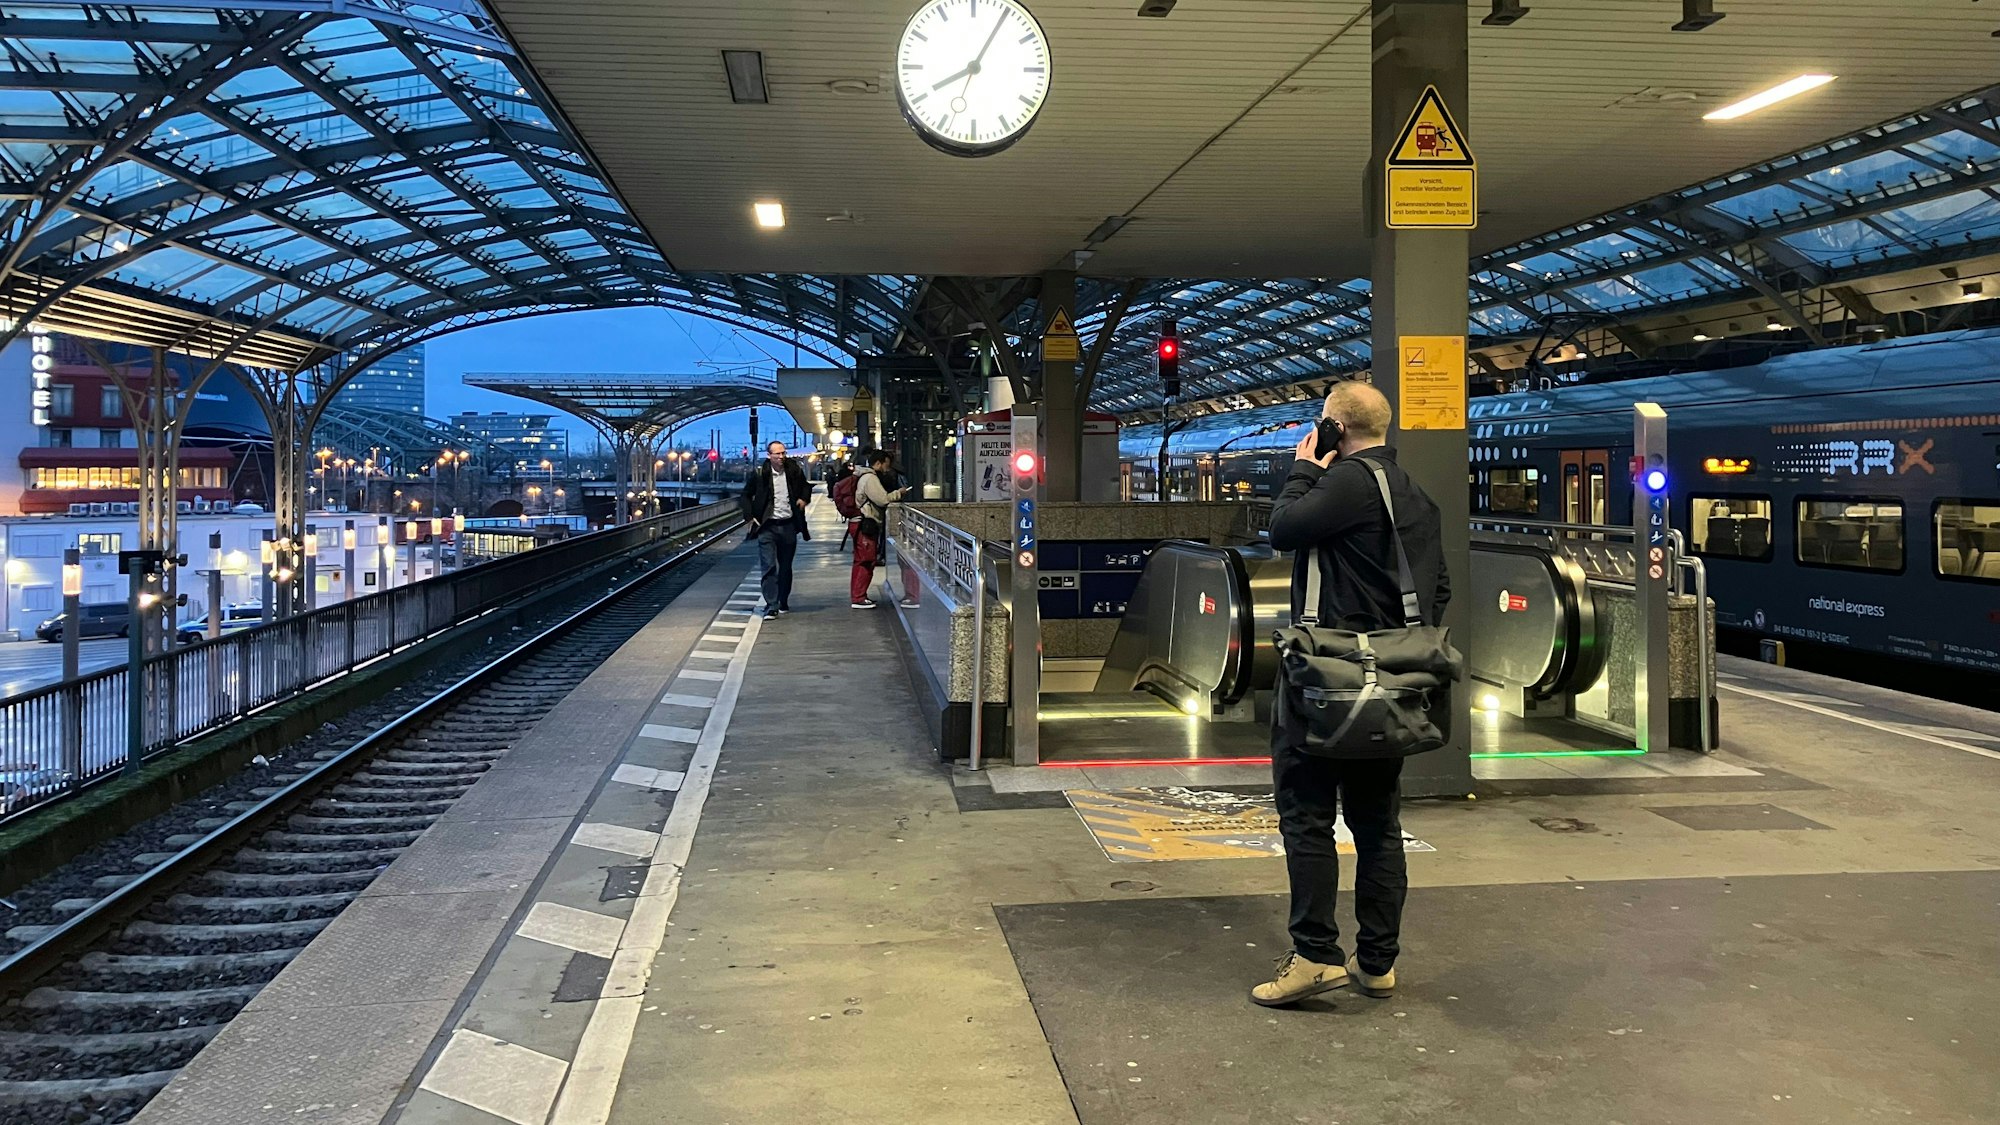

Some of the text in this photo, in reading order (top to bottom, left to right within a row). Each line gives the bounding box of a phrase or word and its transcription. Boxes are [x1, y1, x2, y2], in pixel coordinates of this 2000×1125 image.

[32, 335, 52, 426] HOTEL
[981, 441, 999, 449] HEUTE
[1829, 438, 1936, 476] RRX
[1808, 596, 1885, 617] national express
